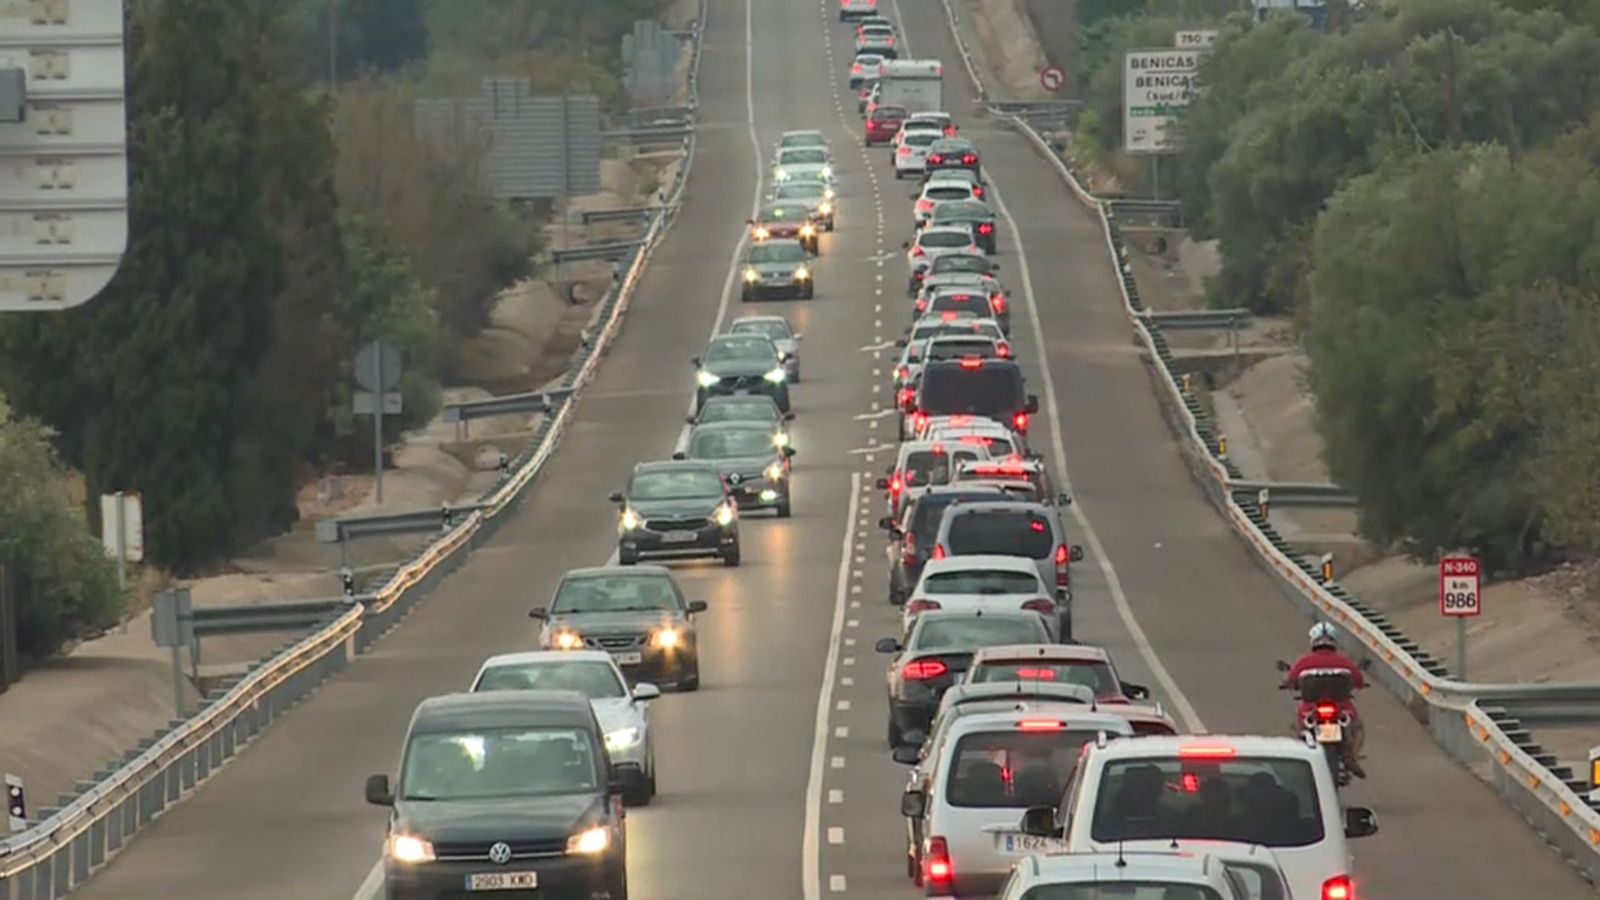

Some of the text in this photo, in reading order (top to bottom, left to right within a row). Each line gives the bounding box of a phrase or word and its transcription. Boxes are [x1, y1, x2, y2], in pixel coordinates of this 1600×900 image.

[1182, 33, 1202, 44] 750
[1444, 561, 1477, 573] N-340
[1452, 580, 1469, 590] km
[1445, 592, 1476, 608] 986
